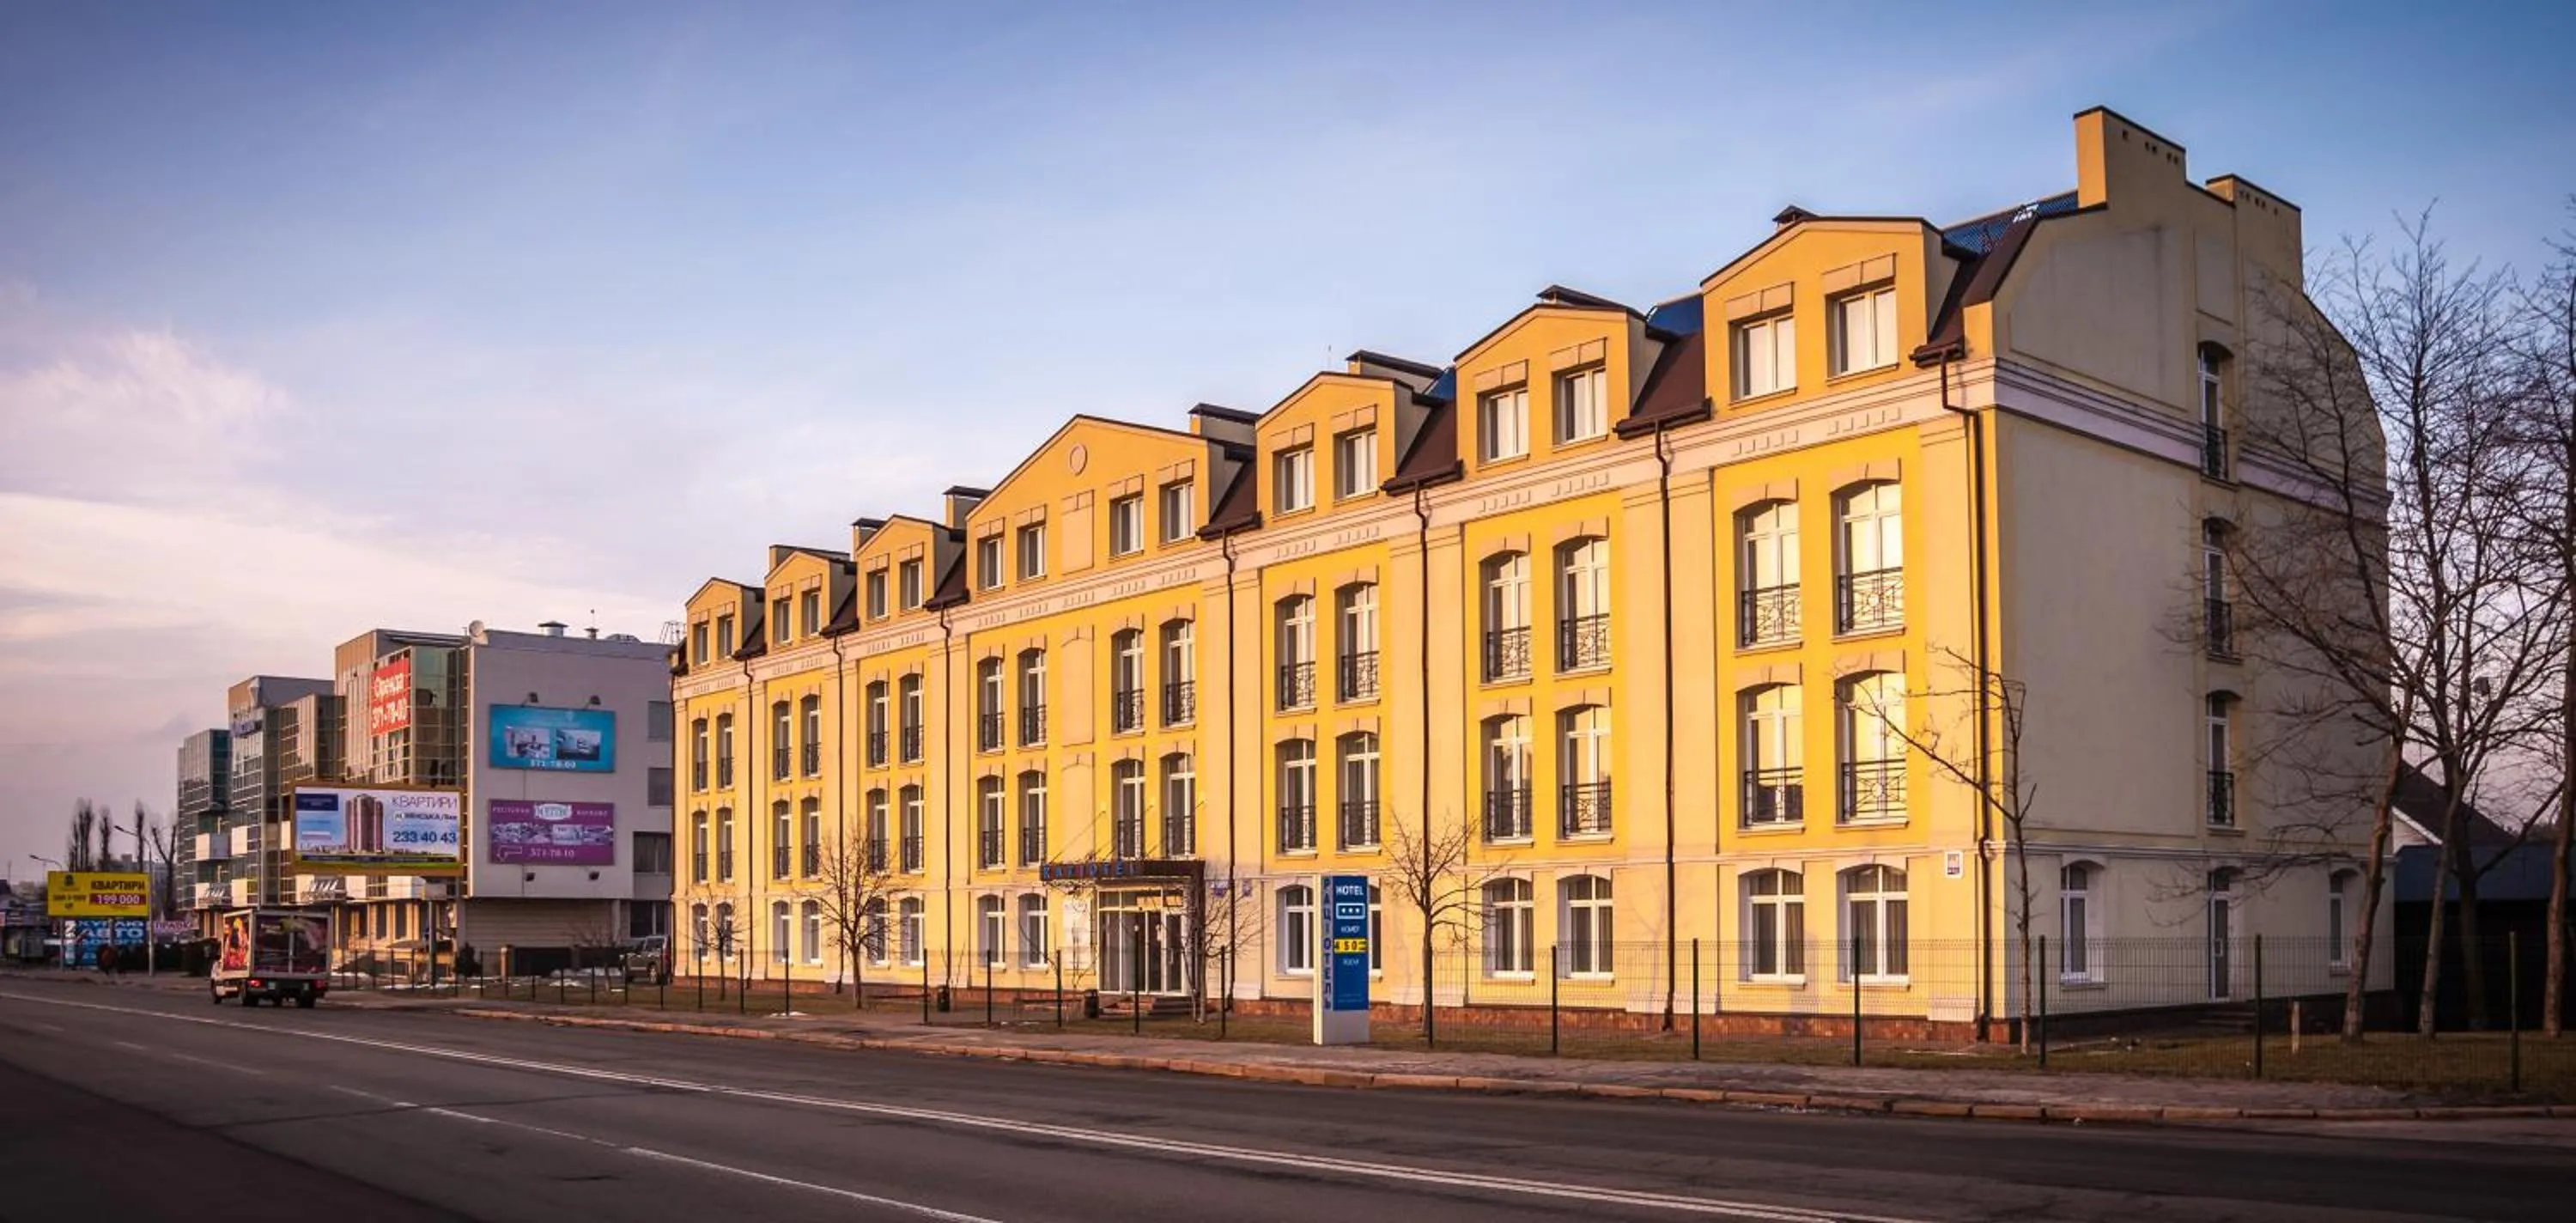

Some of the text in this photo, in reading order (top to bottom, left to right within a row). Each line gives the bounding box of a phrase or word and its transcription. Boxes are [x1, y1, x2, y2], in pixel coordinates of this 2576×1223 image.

[392, 796, 457, 807] КВАРТИРИ
[392, 831, 457, 843] 233 40 43
[1336, 885, 1364, 896] HOTEL
